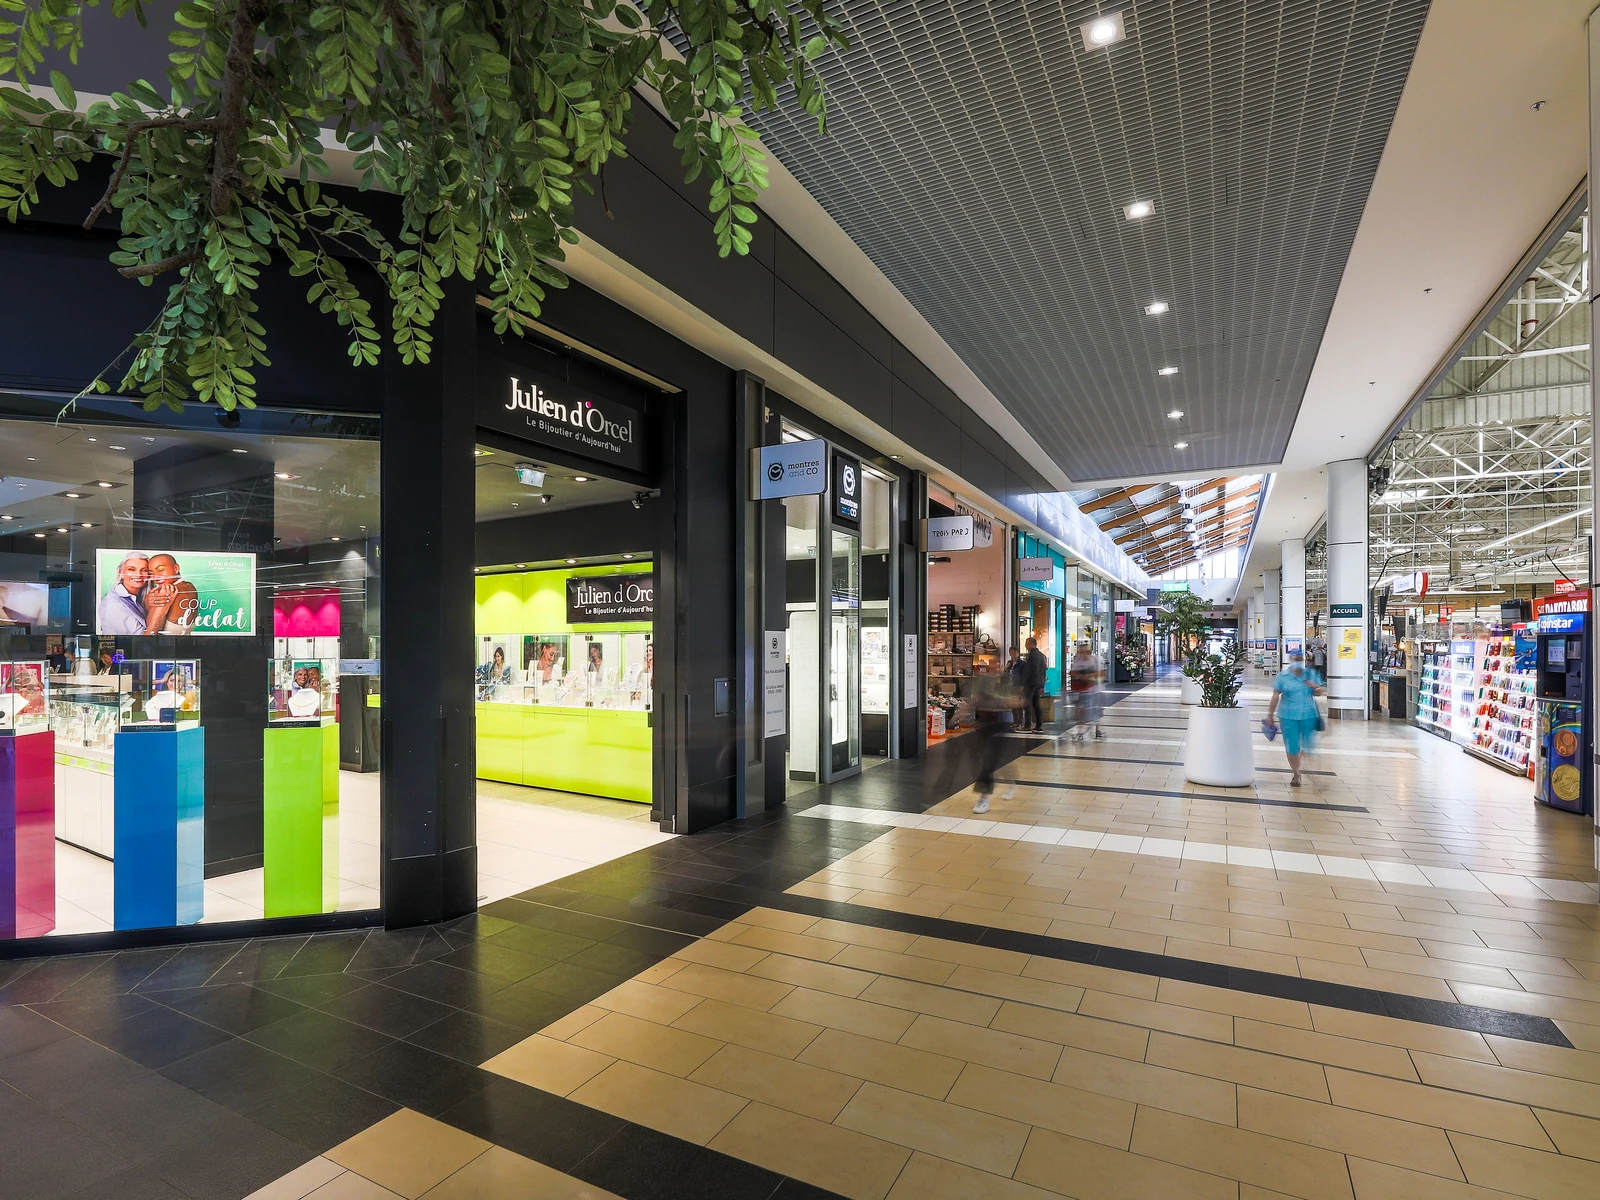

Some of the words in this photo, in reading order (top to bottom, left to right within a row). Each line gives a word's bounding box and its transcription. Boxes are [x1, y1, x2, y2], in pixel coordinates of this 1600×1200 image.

[505, 377, 567, 422] Julien
[526, 416, 536, 427] Le
[539, 421, 573, 438] Bijoutier
[575, 432, 621, 453] d'Aujourd'hui
[788, 461, 819, 469] montres
[789, 469, 804, 477] and
[806, 467, 818, 475] CO
[840, 497, 858, 509] montres
[850, 508, 857, 517] CO
[951, 528, 963, 536] PAR
[964, 528, 969, 536] 3
[574, 586, 611, 608] Julien
[179, 599, 218, 610] COUP
[593, 607, 616, 615] Bijoutier
[177, 607, 247, 629] d'éclat
